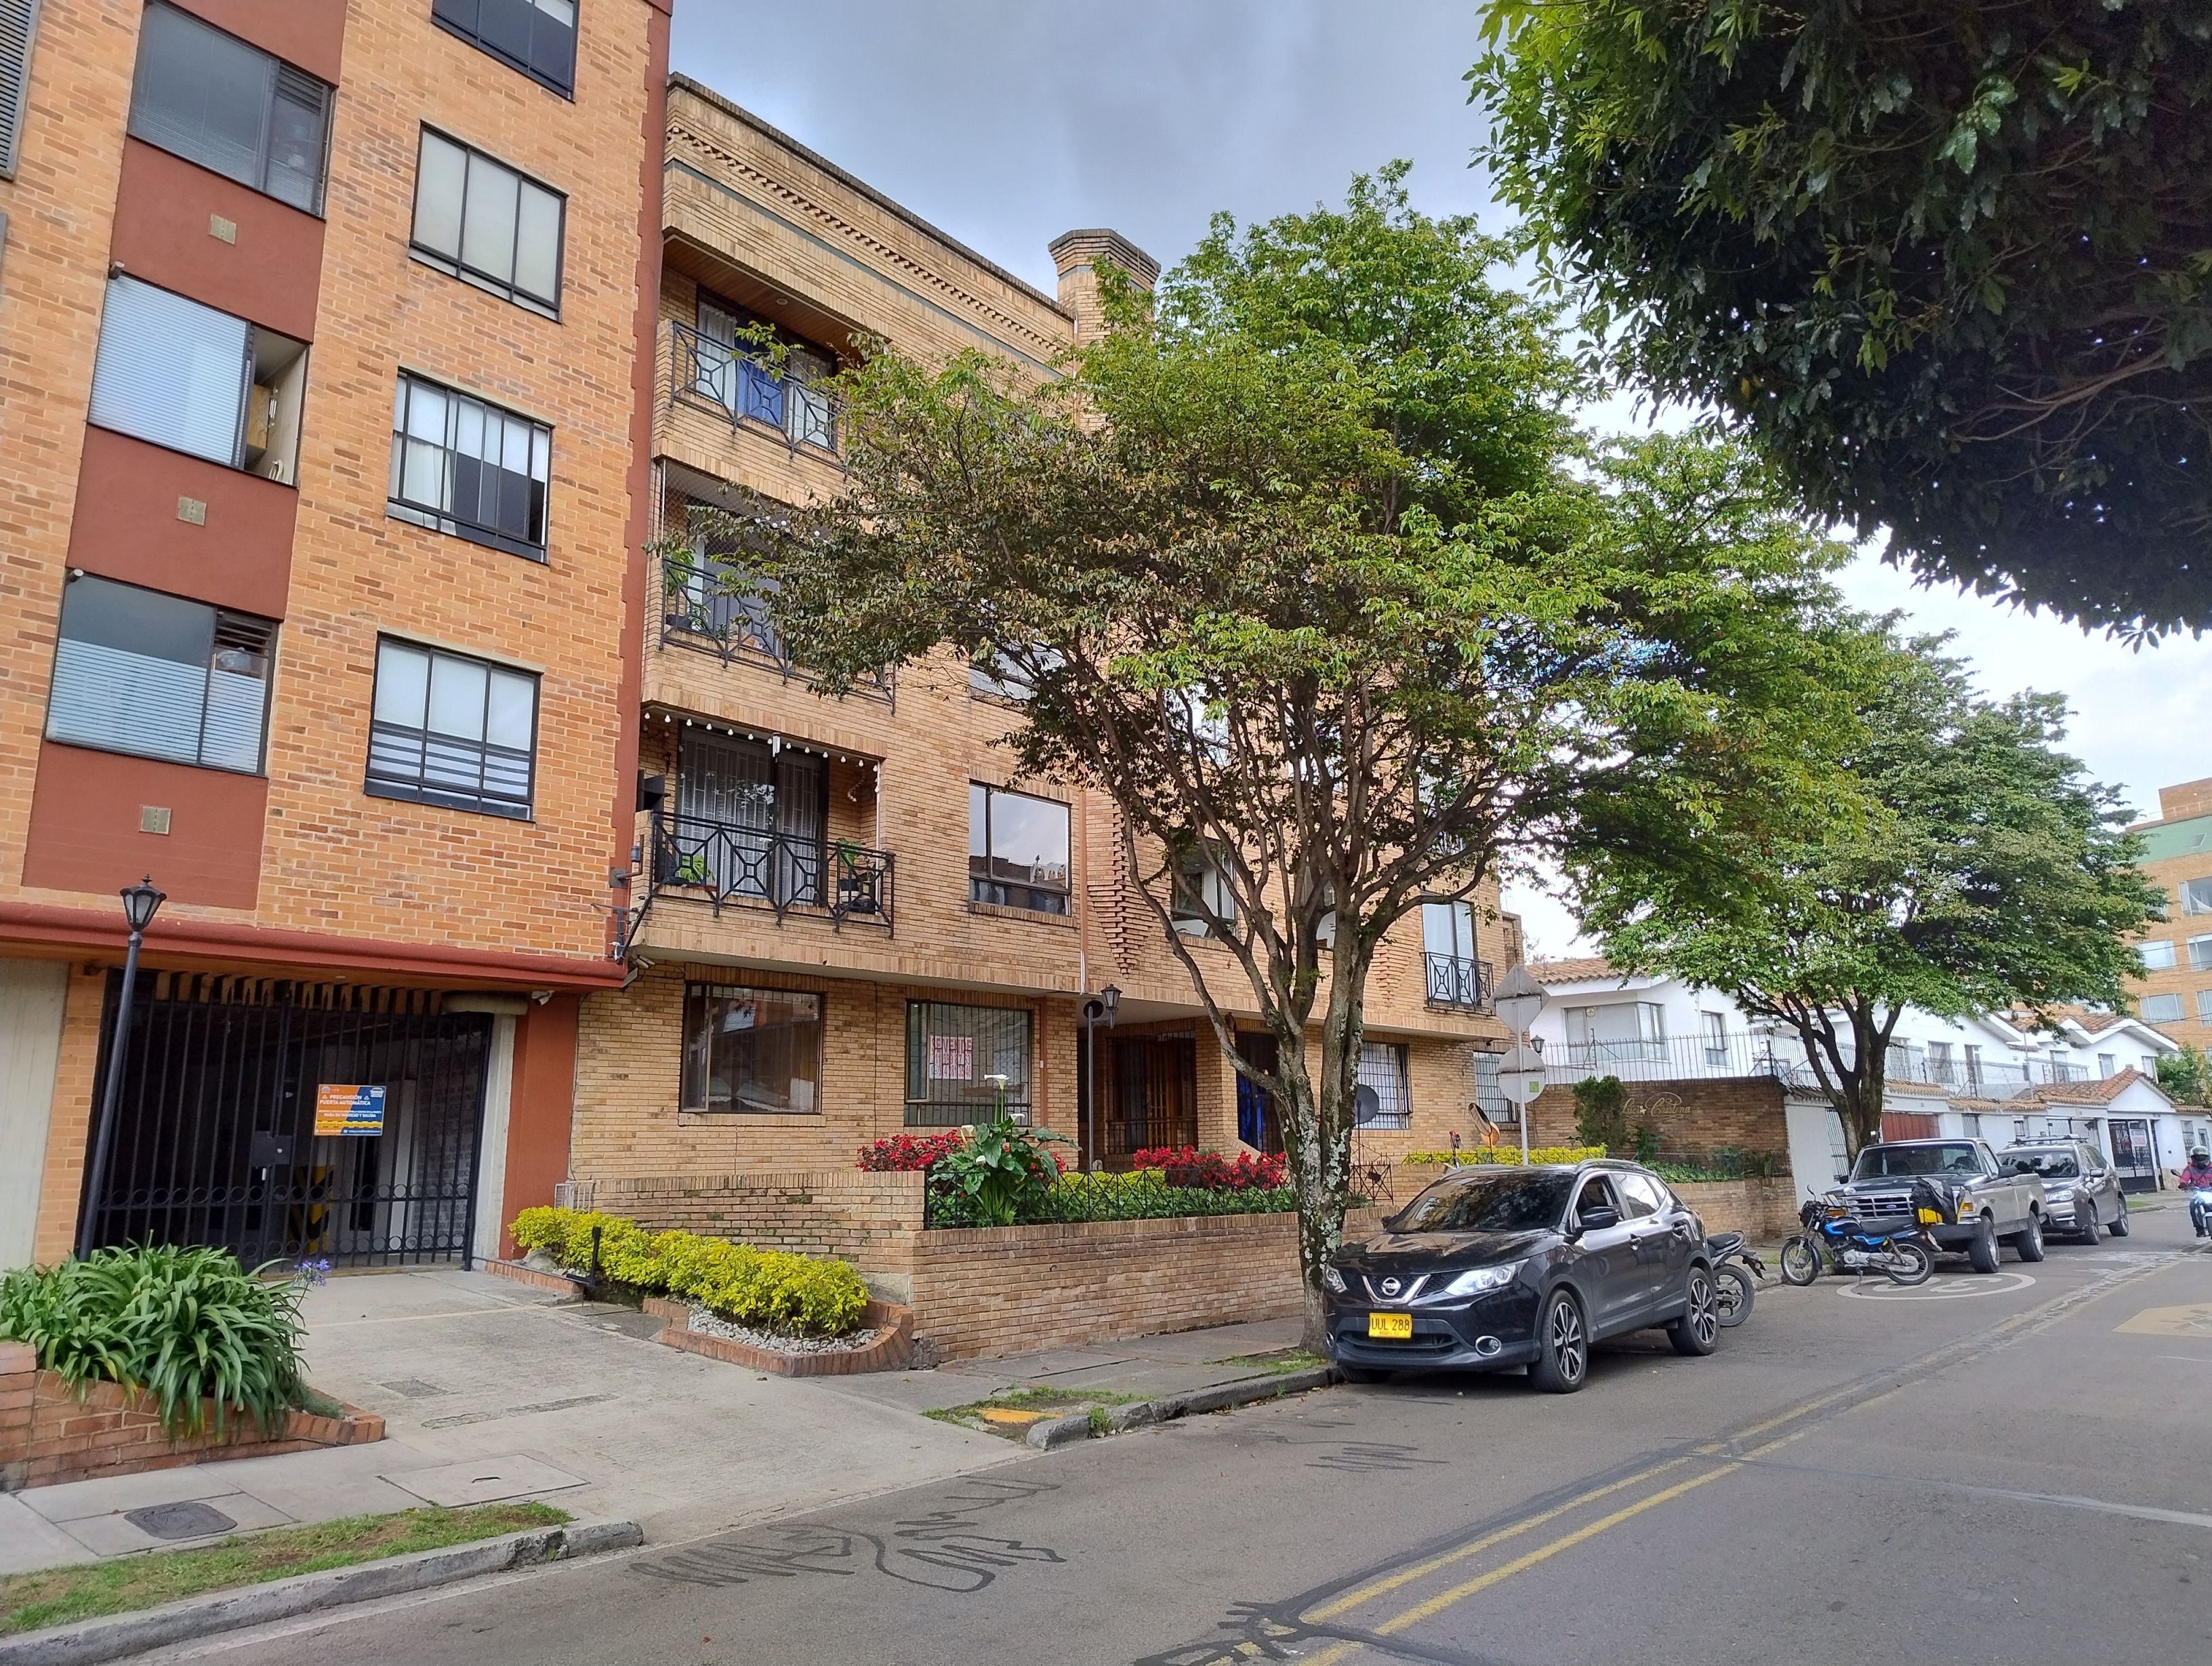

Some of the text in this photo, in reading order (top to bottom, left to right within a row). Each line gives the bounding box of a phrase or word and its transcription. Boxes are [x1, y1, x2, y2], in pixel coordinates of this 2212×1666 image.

[943, 1039, 972, 1053] VENDE
[1372, 1318, 1410, 1330] UUL 288
